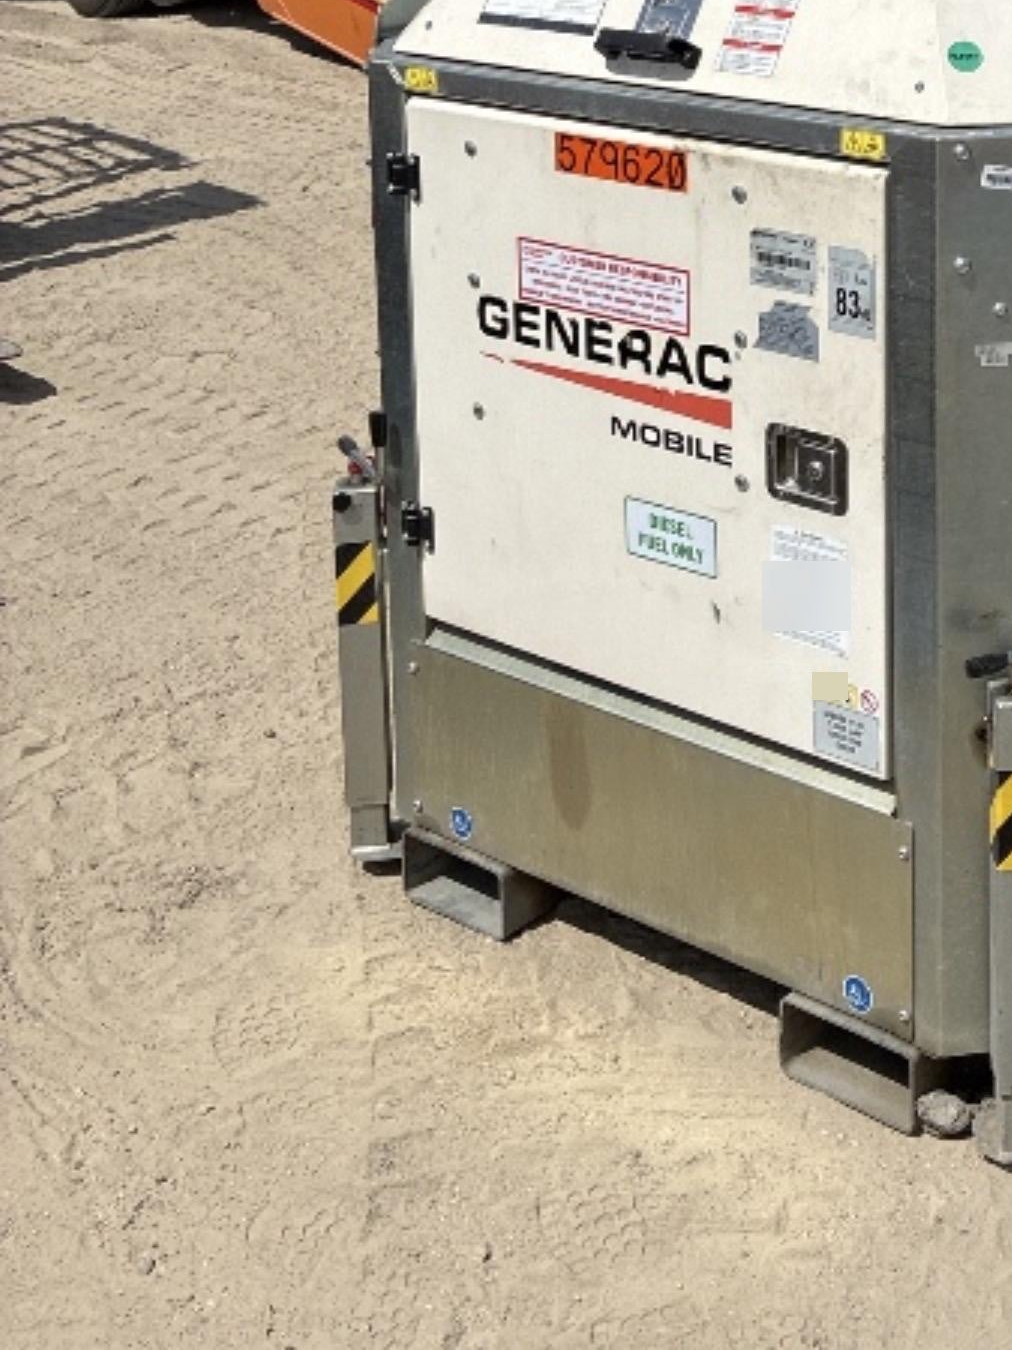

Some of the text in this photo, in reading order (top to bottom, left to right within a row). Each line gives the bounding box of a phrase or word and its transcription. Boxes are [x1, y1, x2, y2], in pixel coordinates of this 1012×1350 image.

[557, 134, 688, 191] 579620
[477, 295, 733, 393] GENERAC
[611, 416, 733, 468] MOBILE
